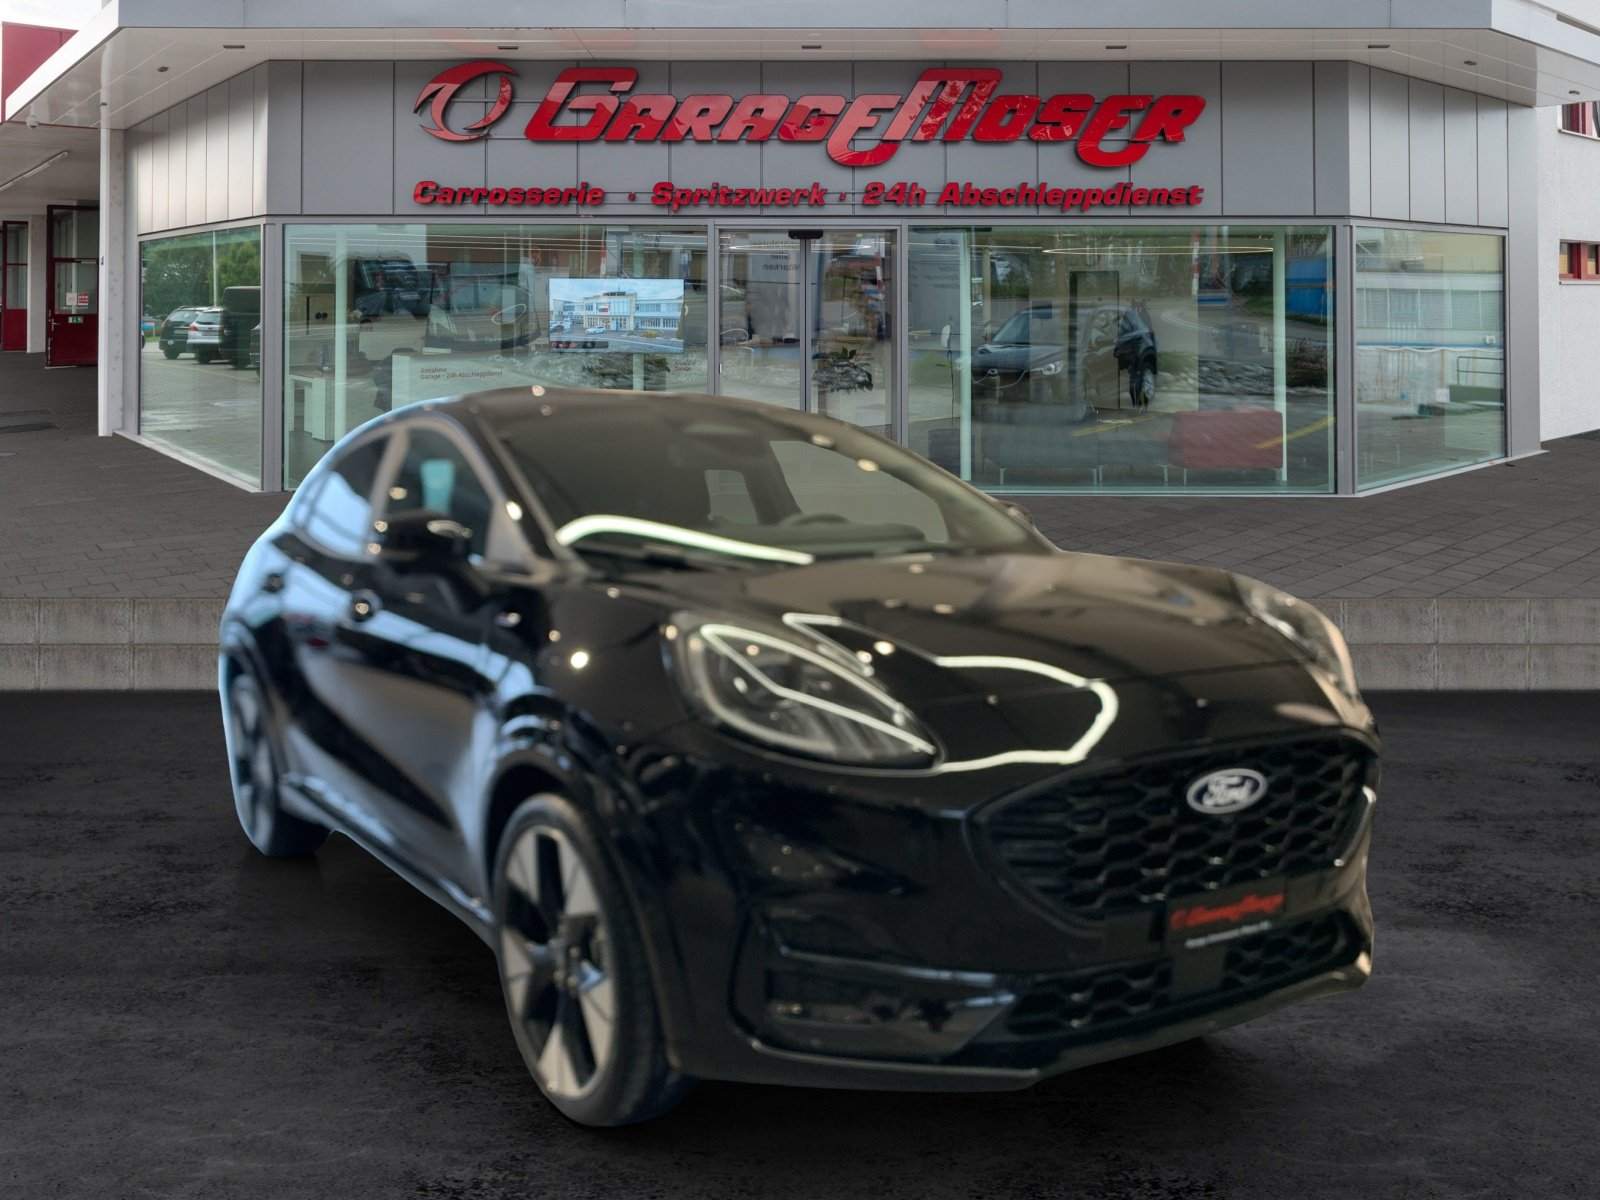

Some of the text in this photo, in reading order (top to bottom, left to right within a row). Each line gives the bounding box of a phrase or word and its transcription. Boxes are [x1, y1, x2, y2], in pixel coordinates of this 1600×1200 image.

[413, 181, 605, 205] Carrosserie
[651, 181, 826, 211] Spritzwerk
[862, 181, 926, 205] 24h
[937, 181, 1204, 211] Abschleppdienst
